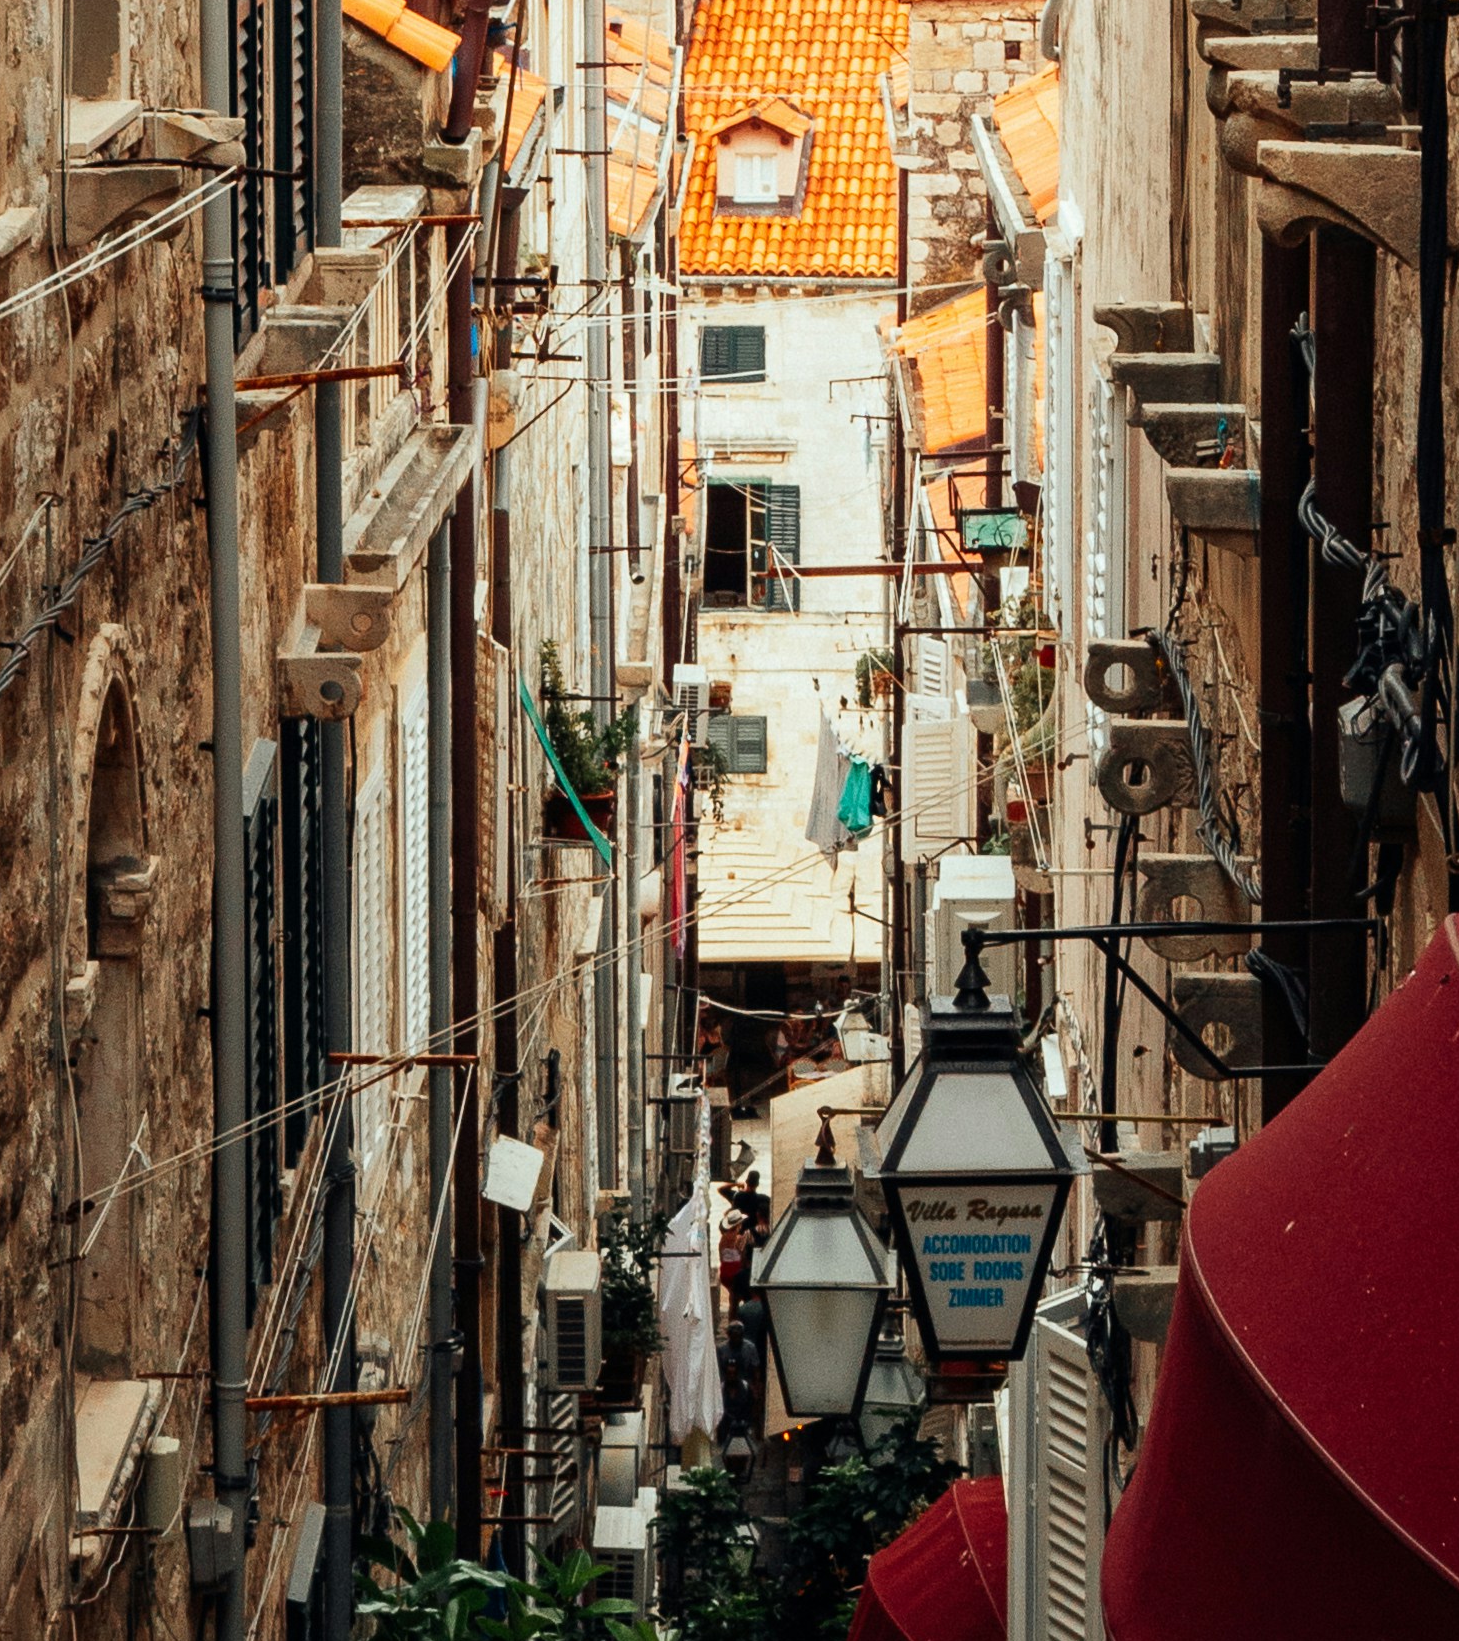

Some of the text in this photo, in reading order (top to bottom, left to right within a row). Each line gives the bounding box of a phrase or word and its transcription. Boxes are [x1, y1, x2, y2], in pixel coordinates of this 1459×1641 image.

[906, 1198, 1044, 1226] Villa Ragusa
[922, 1234, 1032, 1255] ACCOMODATION
[929, 1260, 1024, 1282] SOBE ROOMS
[948, 1287, 1005, 1308] ZIMMER
